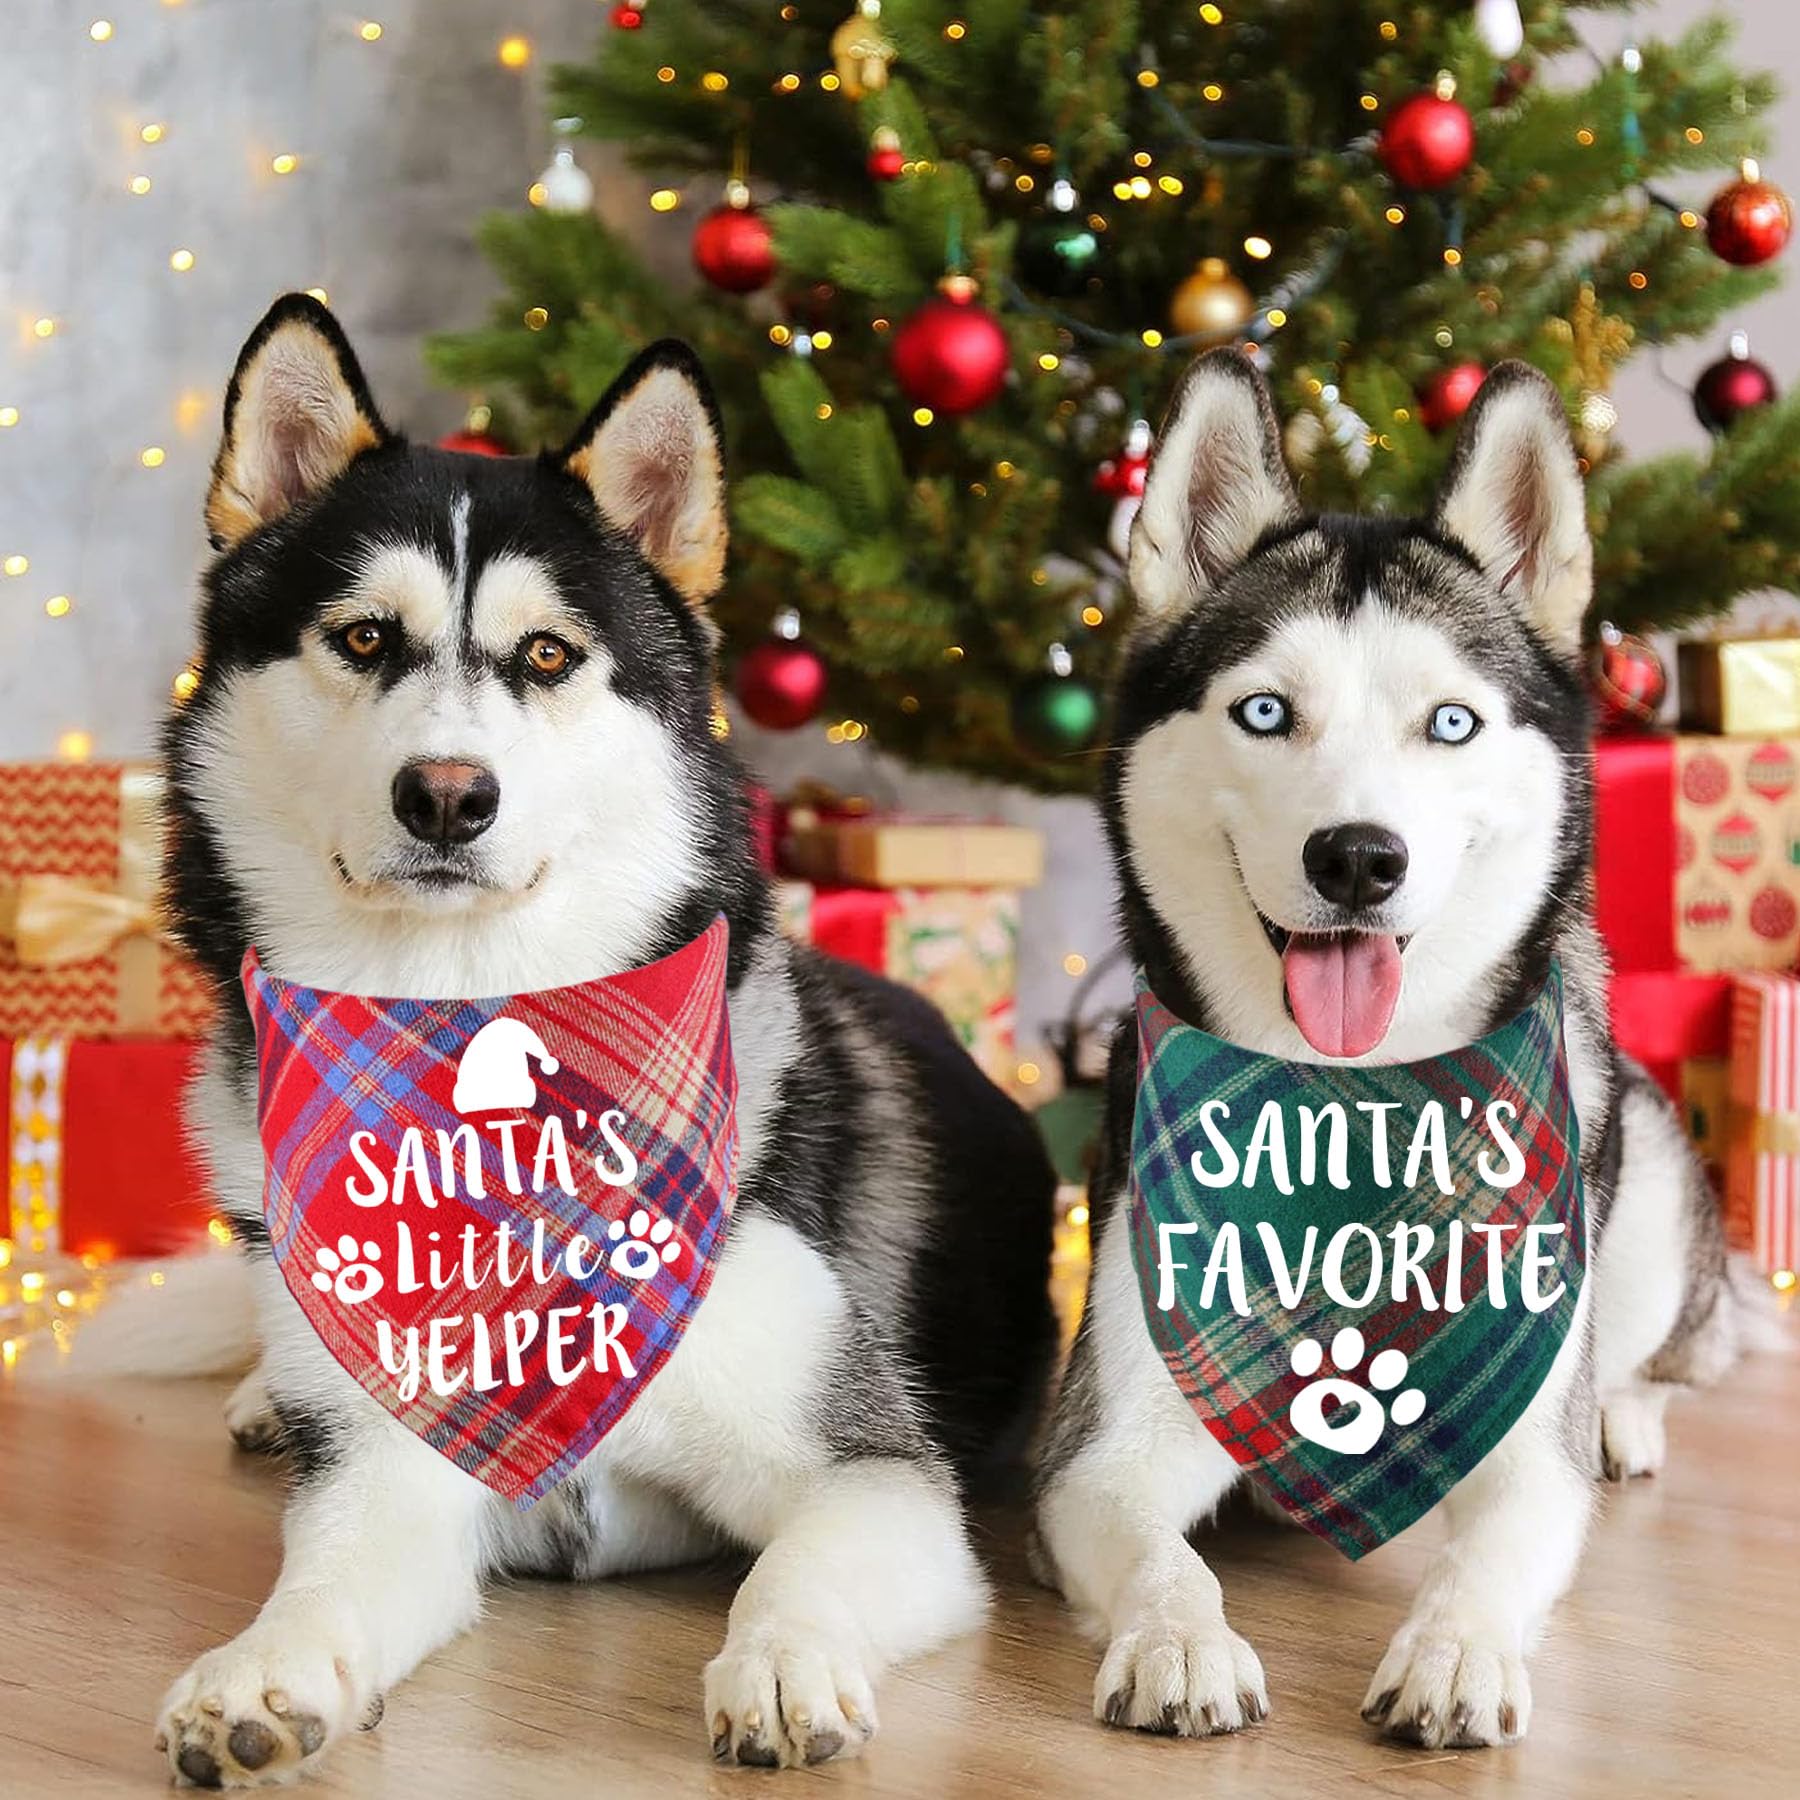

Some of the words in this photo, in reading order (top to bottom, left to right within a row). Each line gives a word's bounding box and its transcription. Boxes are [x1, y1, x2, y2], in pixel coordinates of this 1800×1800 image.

[345, 1108, 638, 1208] SANTA'S
[1190, 1096, 1527, 1196] SANTA'S
[396, 1220, 605, 1294] Little
[1156, 1220, 1568, 1317] FAVORITE
[375, 1302, 638, 1402] YELPER
